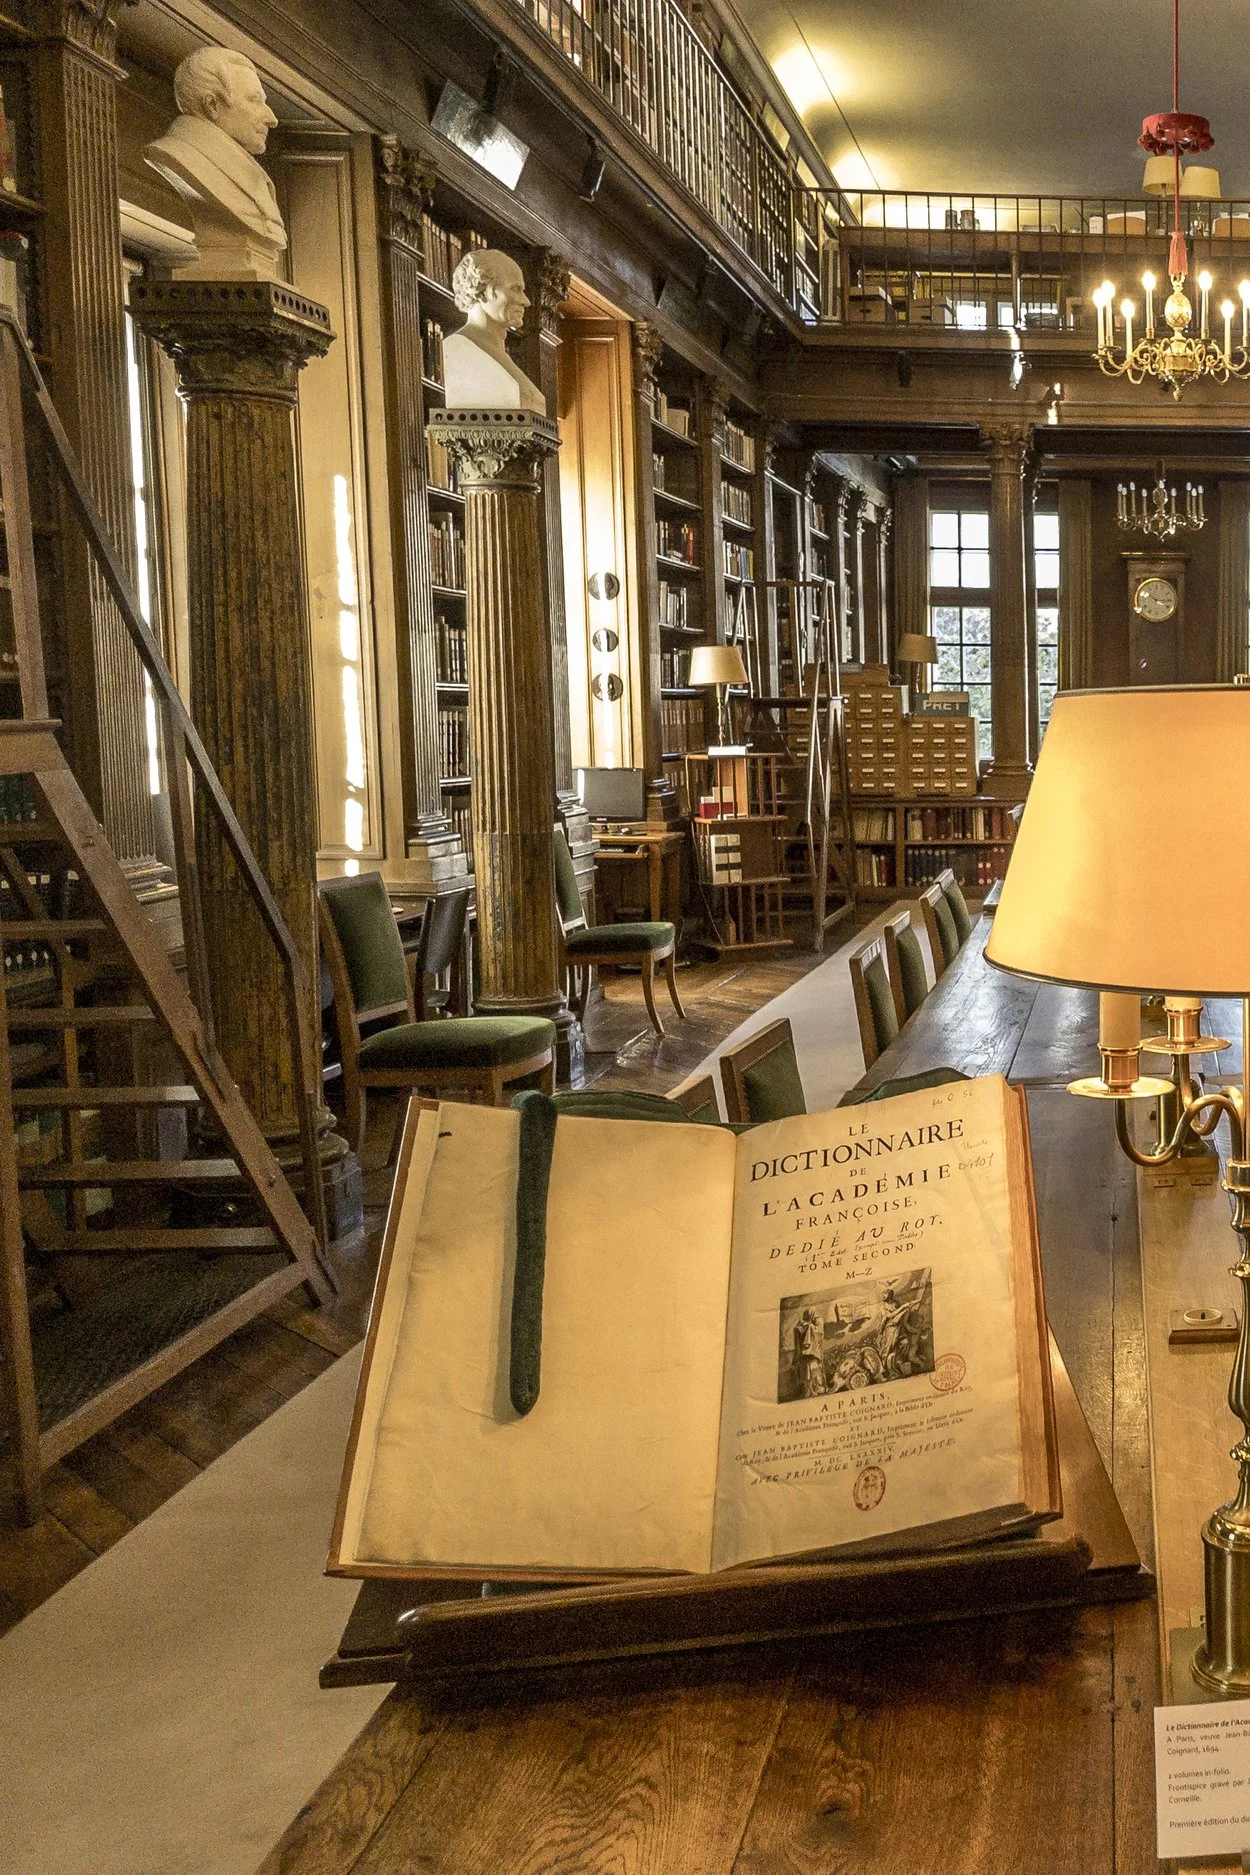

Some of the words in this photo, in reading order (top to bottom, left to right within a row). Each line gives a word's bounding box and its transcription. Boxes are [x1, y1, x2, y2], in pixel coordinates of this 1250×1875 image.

[849, 1123, 869, 1136] LE
[750, 1118, 964, 1183] DICTIONNAIRE
[849, 1167, 867, 1177] DE
[762, 1163, 951, 1217] L'ACADÉMIE
[795, 1196, 917, 1230] FRANÇOISE,
[855, 1226, 884, 1243] AU
[900, 1214, 943, 1233] ROY.
[798, 1258, 842, 1273] TOME
[821, 1403, 828, 1412] A
[786, 1418, 807, 1428] JEAN
[808, 1411, 847, 1424] BAPTISTE
[753, 1447, 776, 1458] JEAN
[780, 1439, 826, 1453] BAPTISTE
[832, 1428, 885, 1444] COIGNARD,
[785, 1463, 848, 1480] PRIVILEGE
[856, 1459, 870, 1468] DE
[877, 1454, 892, 1463] SA
[1176, 1720, 1219, 1731] Dictionnaire
[1220, 1719, 1229, 1727] de
[1176, 1735, 1196, 1743] Paris,
[1200, 1733, 1220, 1741] veuve
[1167, 1746, 1201, 1756] Coignard,
[1174, 1770, 1203, 1779] volumes
[1168, 1782, 1207, 1792] Frontispice
[1209, 1780, 1230, 1790] gravé
[1232, 1780, 1244, 1788] par
[1169, 1819, 1202, 1829] Première
[1203, 1817, 1229, 1827] édition
[1229, 1815, 1239, 1824] du
